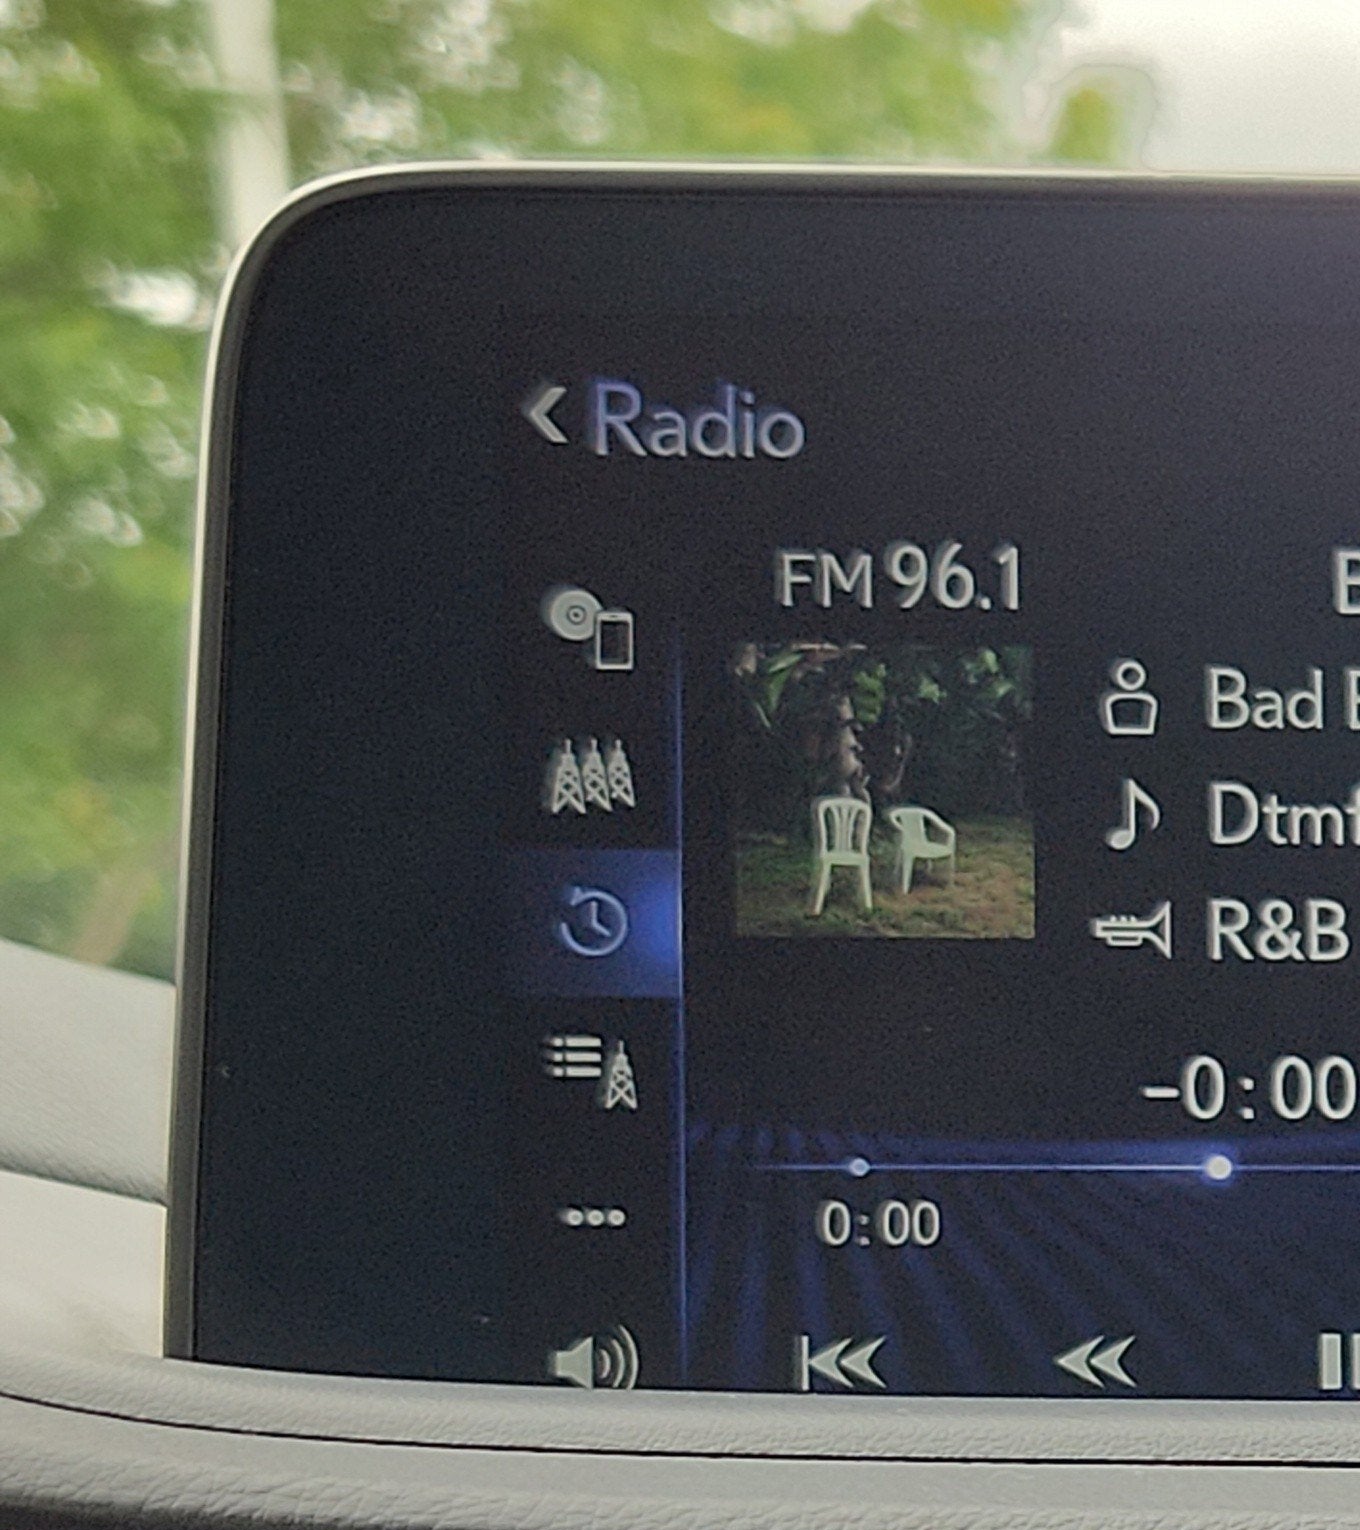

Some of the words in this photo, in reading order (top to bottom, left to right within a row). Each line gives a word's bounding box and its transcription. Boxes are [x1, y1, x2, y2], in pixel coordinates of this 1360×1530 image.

[592, 380, 806, 459] Radio
[778, 550, 874, 609] FM
[887, 542, 1021, 611] 96.1
[1206, 665, 1324, 731] Bad
[1205, 898, 1351, 962] R&B
[1140, 1054, 1358, 1121] -0:00
[818, 1200, 943, 1247] 0:00
